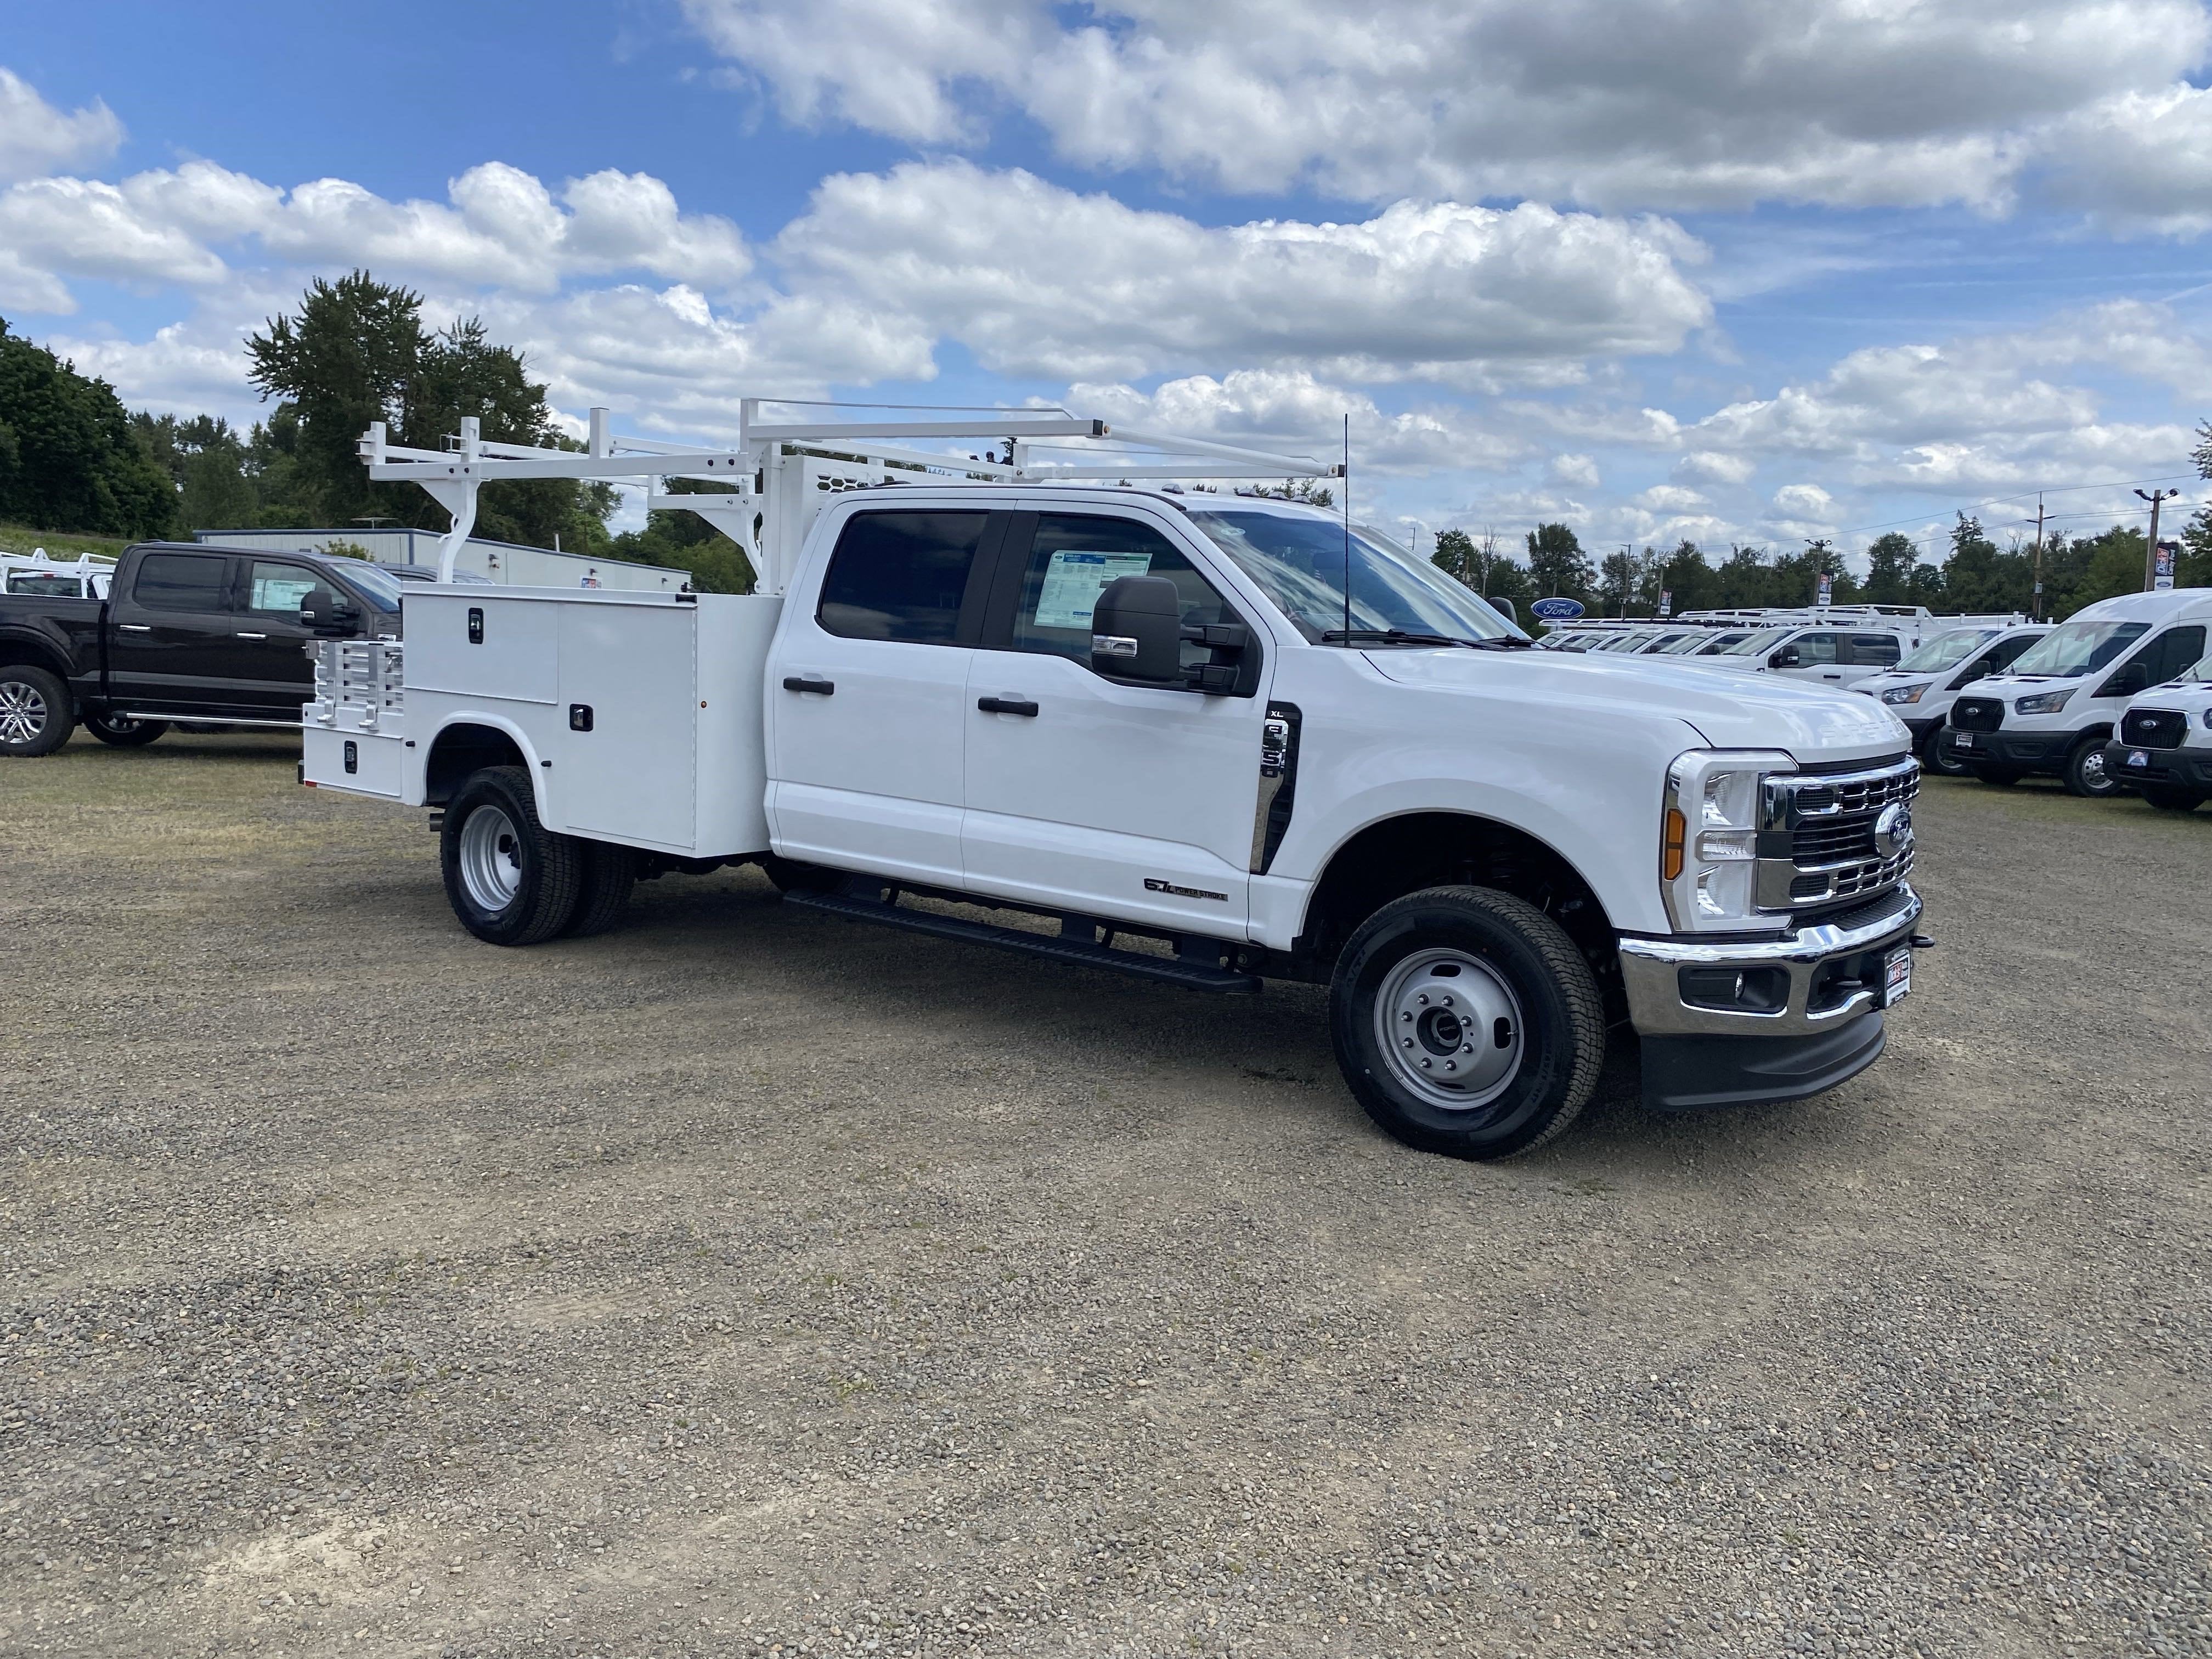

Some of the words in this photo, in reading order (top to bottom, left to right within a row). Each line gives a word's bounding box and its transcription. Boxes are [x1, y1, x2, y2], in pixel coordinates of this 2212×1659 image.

[1543, 602, 1574, 615] Ford
[1175, 886, 1199, 896] POWER
[1199, 890, 1226, 900] STROKE
